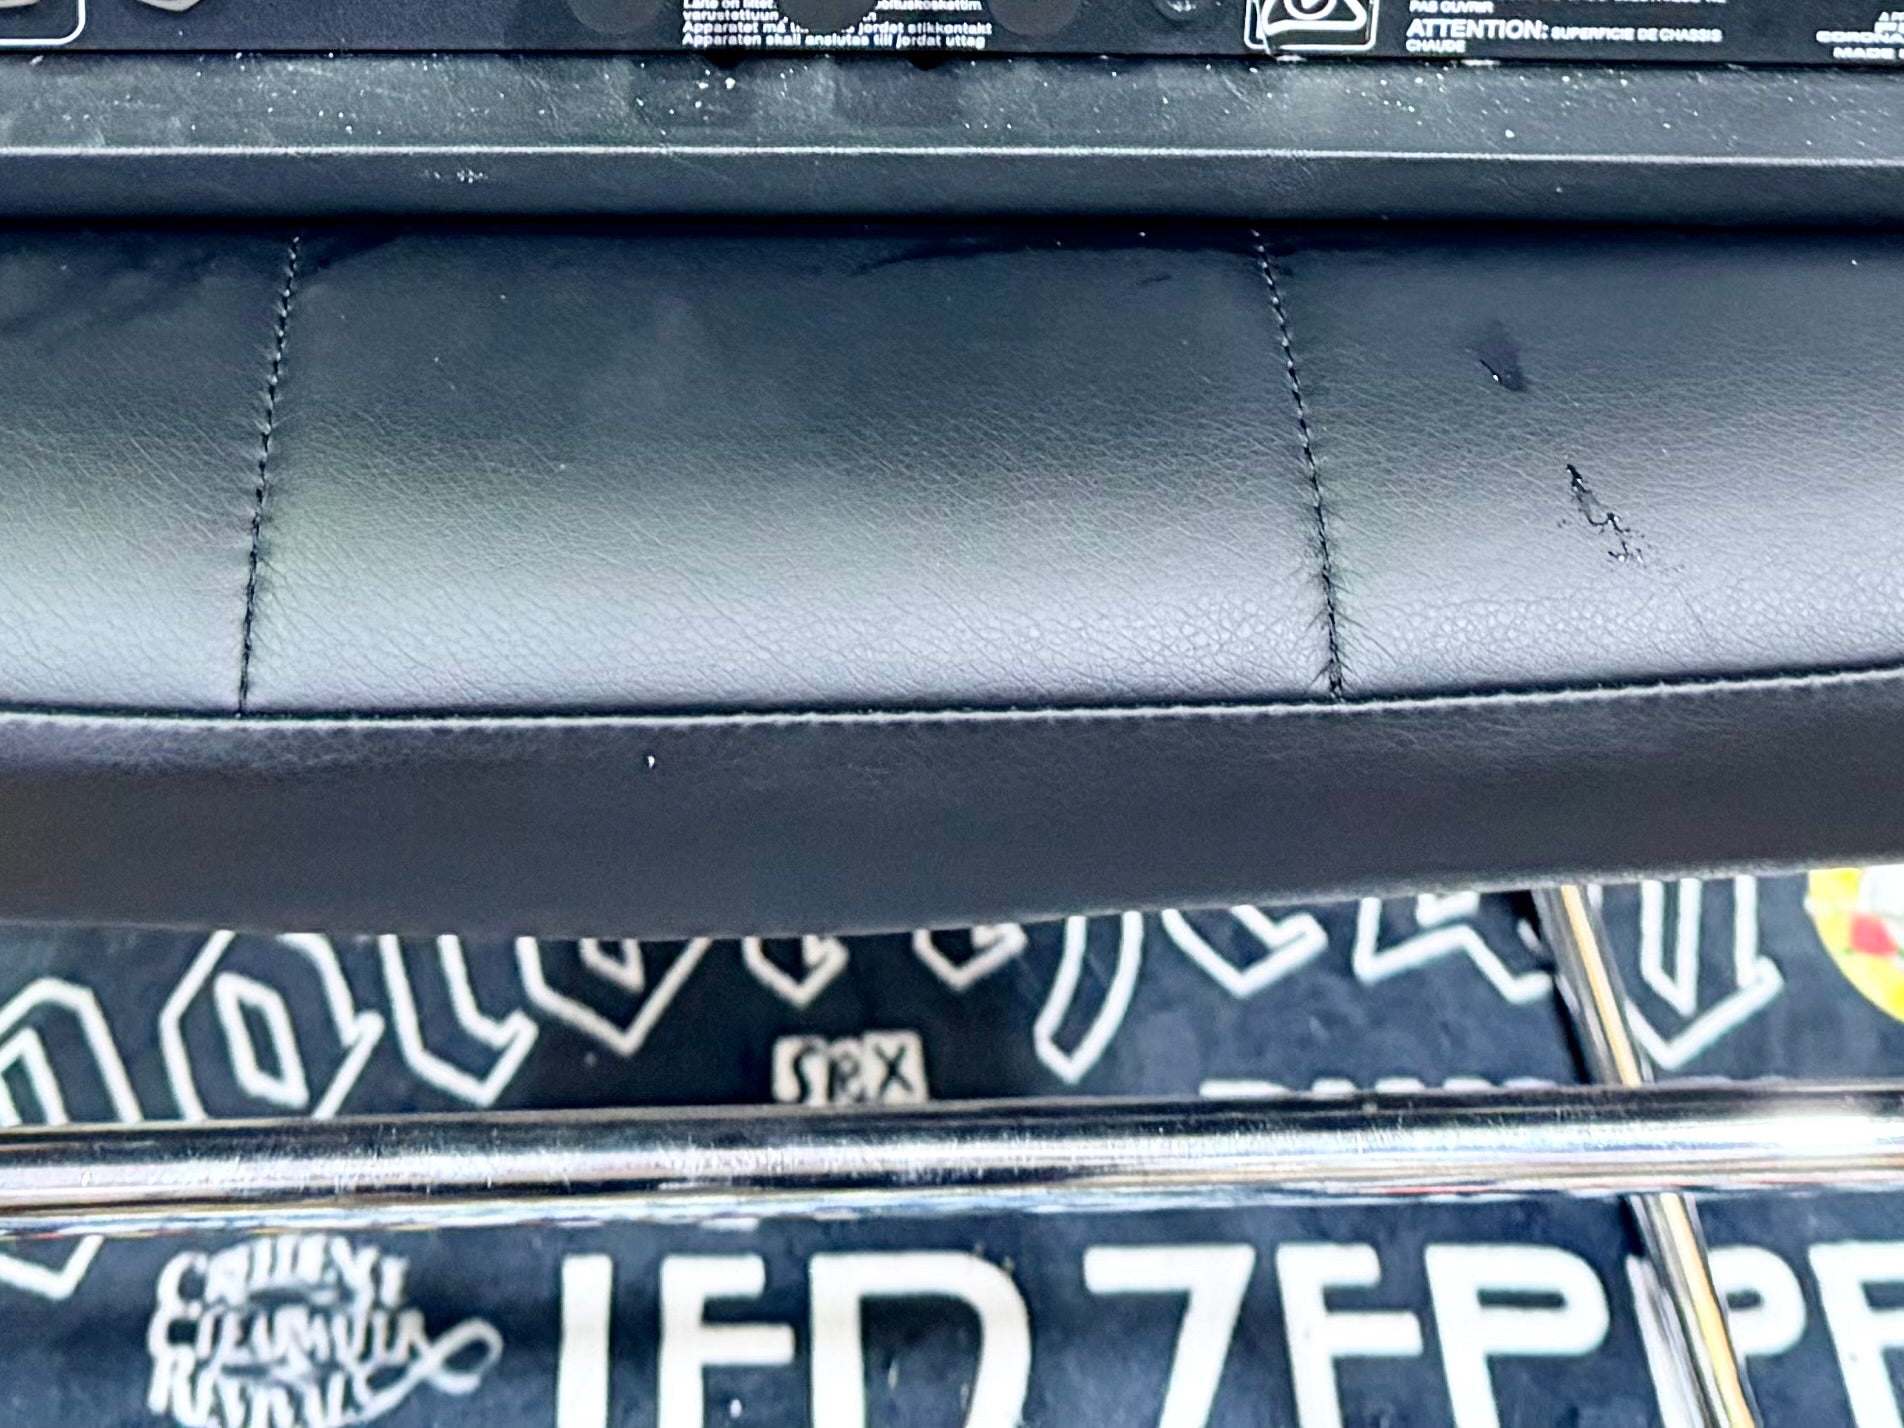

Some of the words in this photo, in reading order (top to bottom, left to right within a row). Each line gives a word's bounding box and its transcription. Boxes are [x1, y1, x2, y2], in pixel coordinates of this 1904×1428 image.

[1409, 0, 1437, 13] PAS
[1440, 0, 1494, 14] OUVRIR
[1406, 18, 1549, 39] ATTENTION:
[1551, 26, 1635, 41] SUPERFICIE
[1637, 28, 1659, 41] DE
[1659, 28, 1723, 42] CHASSIS
[1406, 40, 1466, 53] CHAUDE
[1833, 47, 1895, 61] MADE
